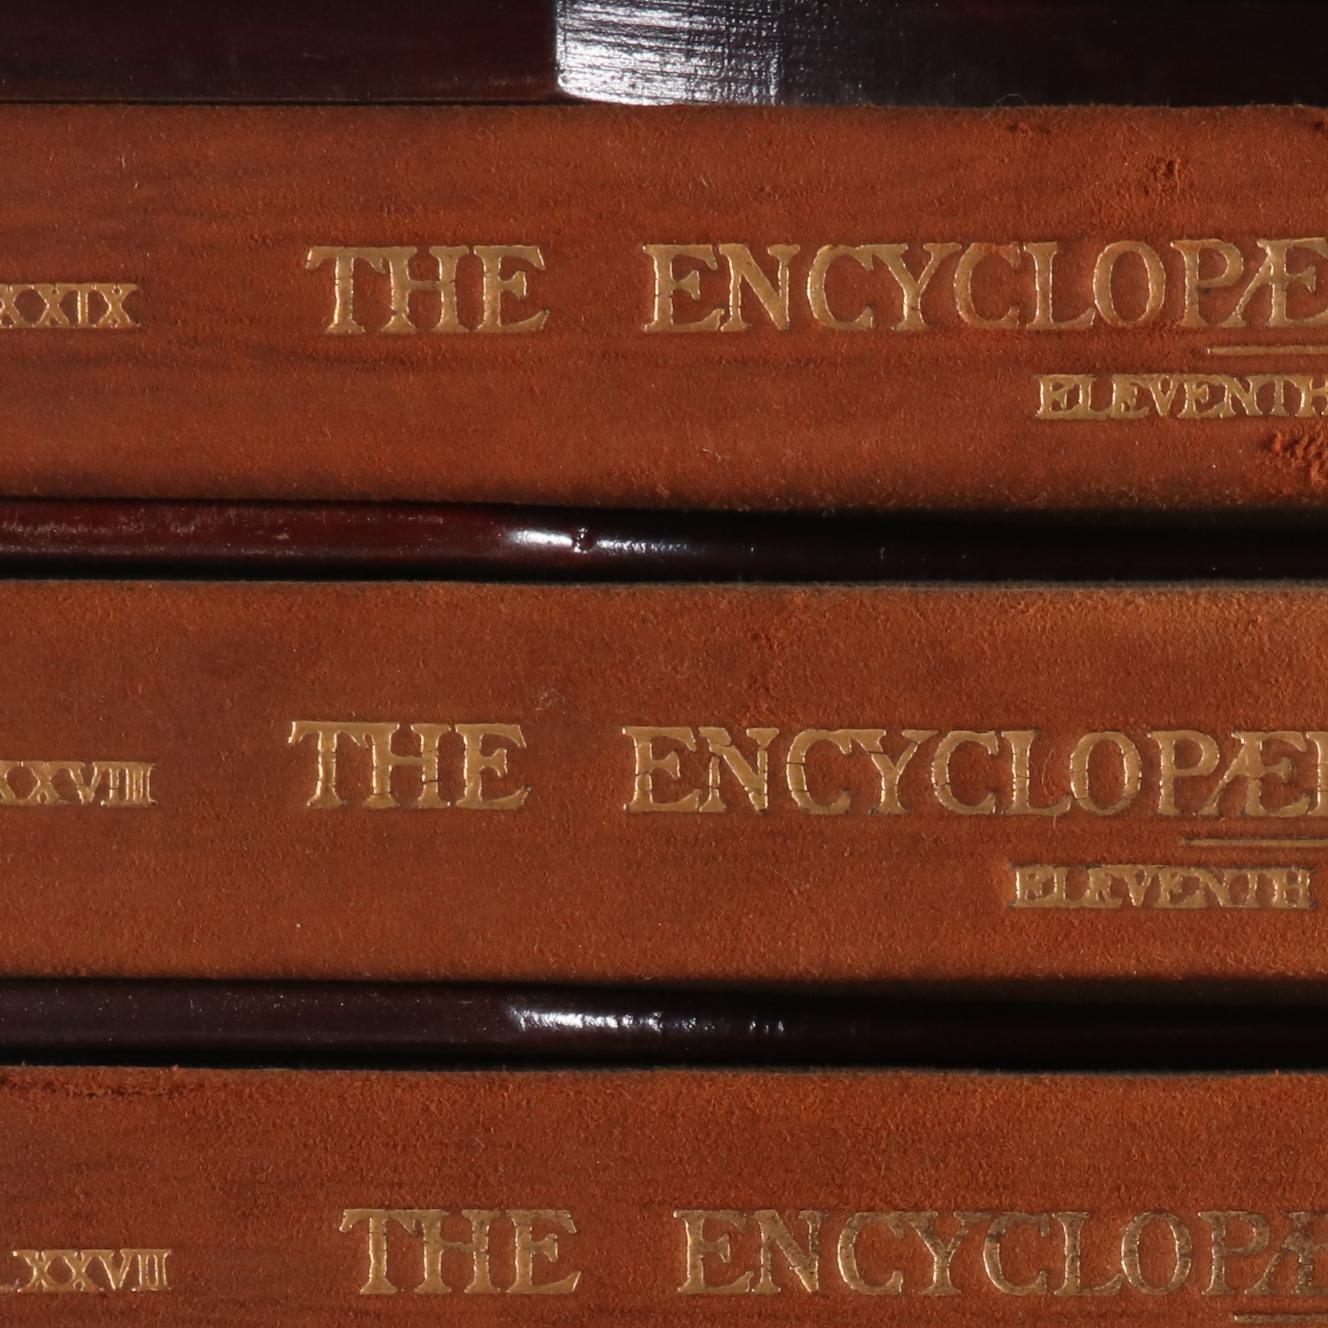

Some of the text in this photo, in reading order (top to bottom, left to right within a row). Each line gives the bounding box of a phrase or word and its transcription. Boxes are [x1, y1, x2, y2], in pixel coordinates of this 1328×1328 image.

[304, 244, 550, 334] THE
[286, 719, 531, 810] THE
[1012, 863, 1311, 909] ELEVENTH
[12, 1248, 172, 1293] XXVII
[334, 1208, 582, 1295] THE
